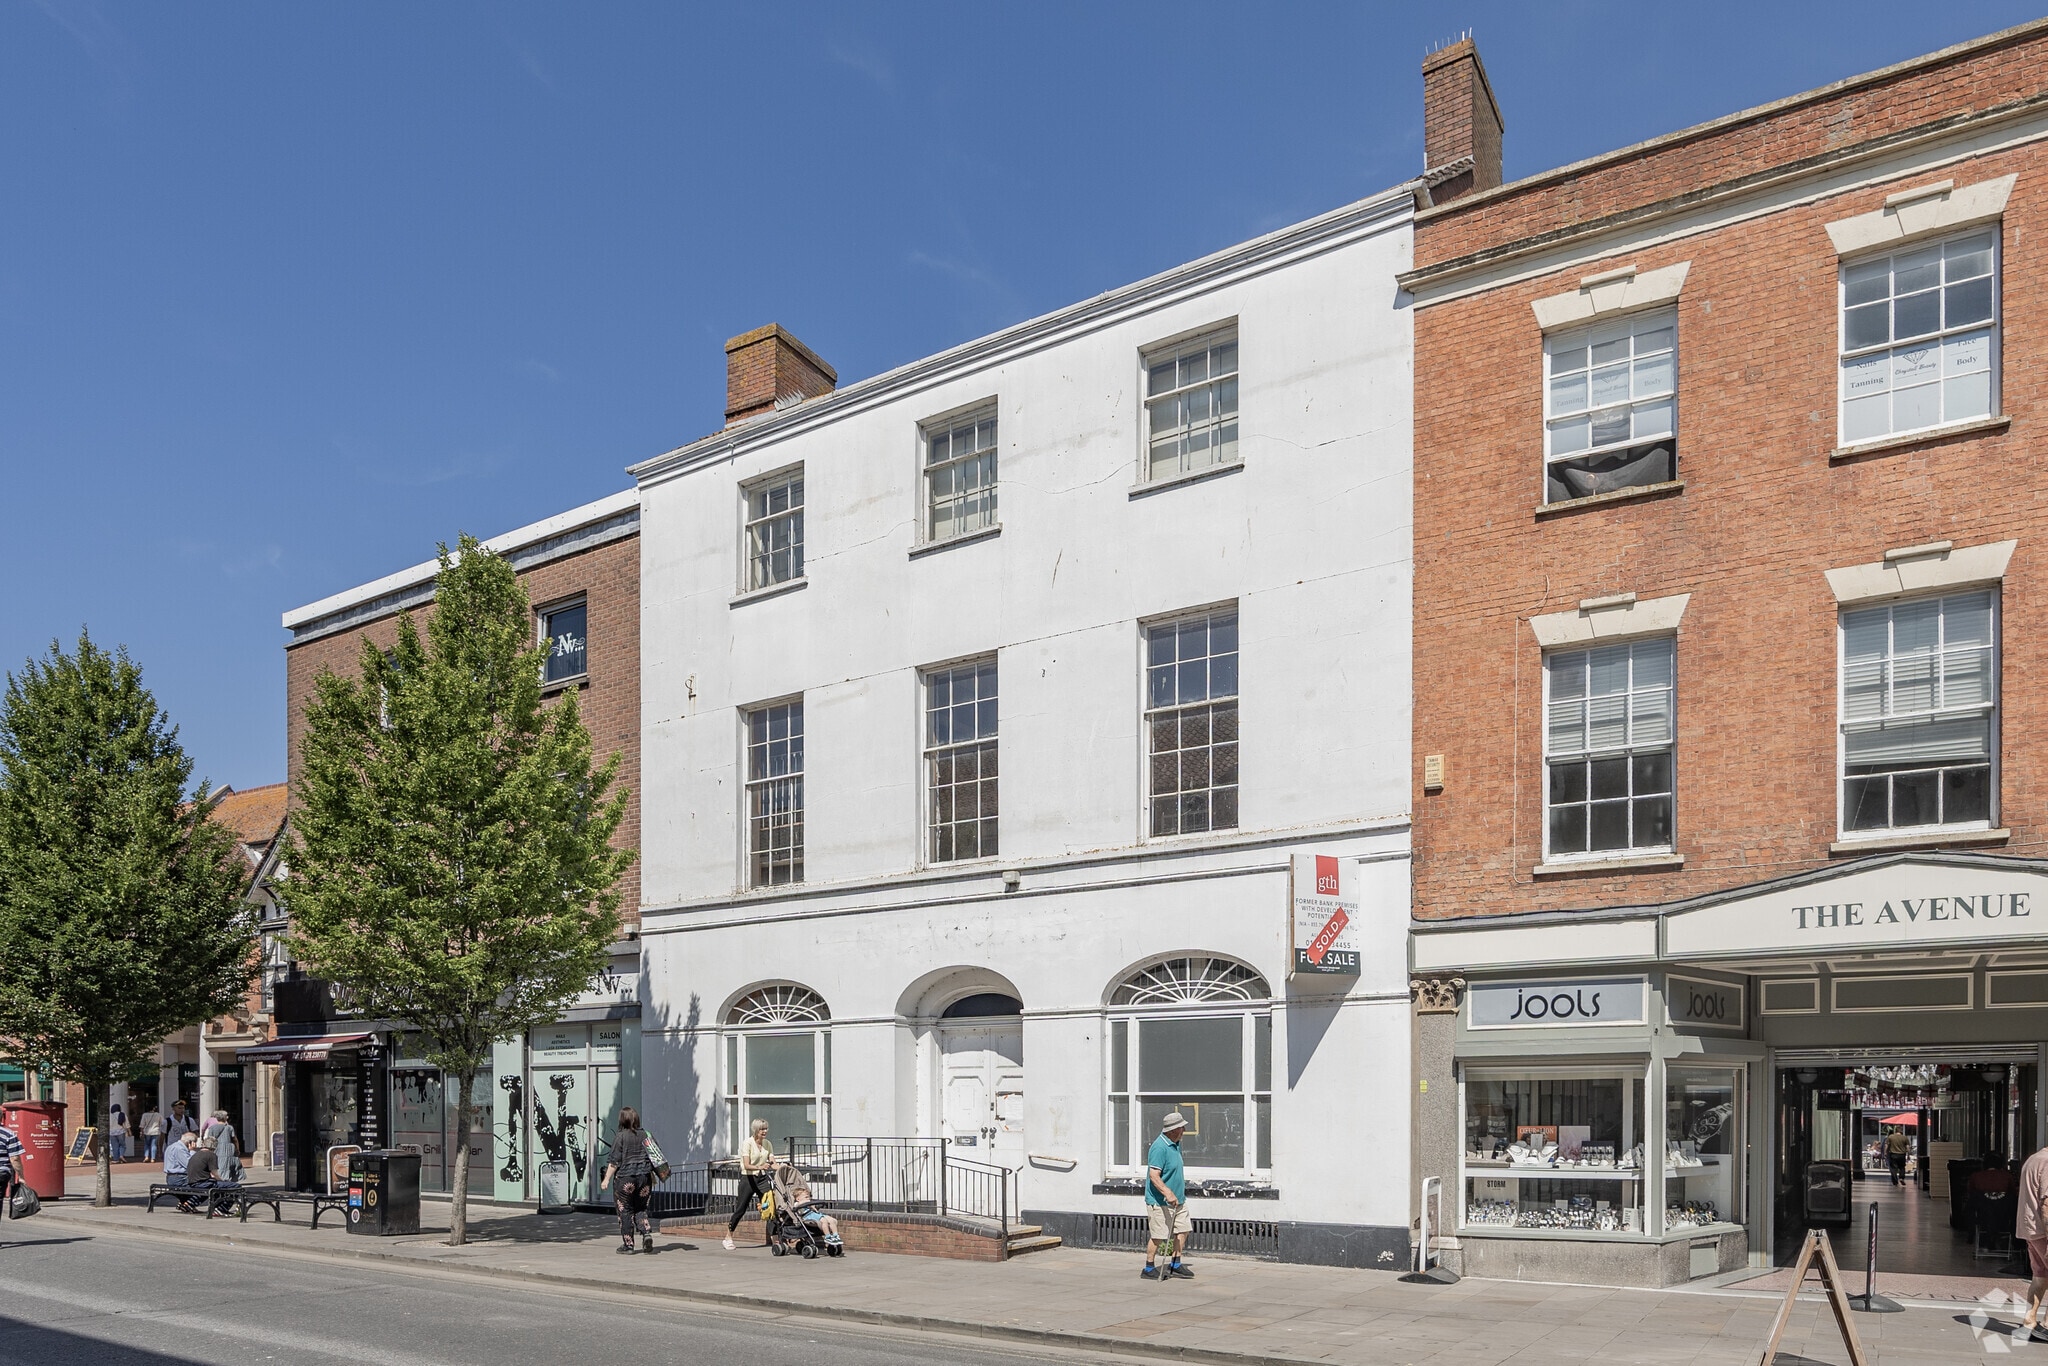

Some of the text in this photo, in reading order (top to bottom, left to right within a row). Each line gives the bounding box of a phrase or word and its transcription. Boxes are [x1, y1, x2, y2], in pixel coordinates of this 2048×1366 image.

[1956, 356, 1977, 366] Body
[1850, 377, 1884, 389] Tanning
[1318, 875, 1338, 892] gth
[1792, 892, 2031, 930] THE AVENUE
[1315, 921, 1339, 952] SOLD
[1327, 953, 1355, 966] SALE
[1511, 988, 1600, 1020] jools
[1686, 986, 1725, 1020] jools
[599, 1031, 621, 1040] SALON
[1486, 1180, 1506, 1188] STORM
